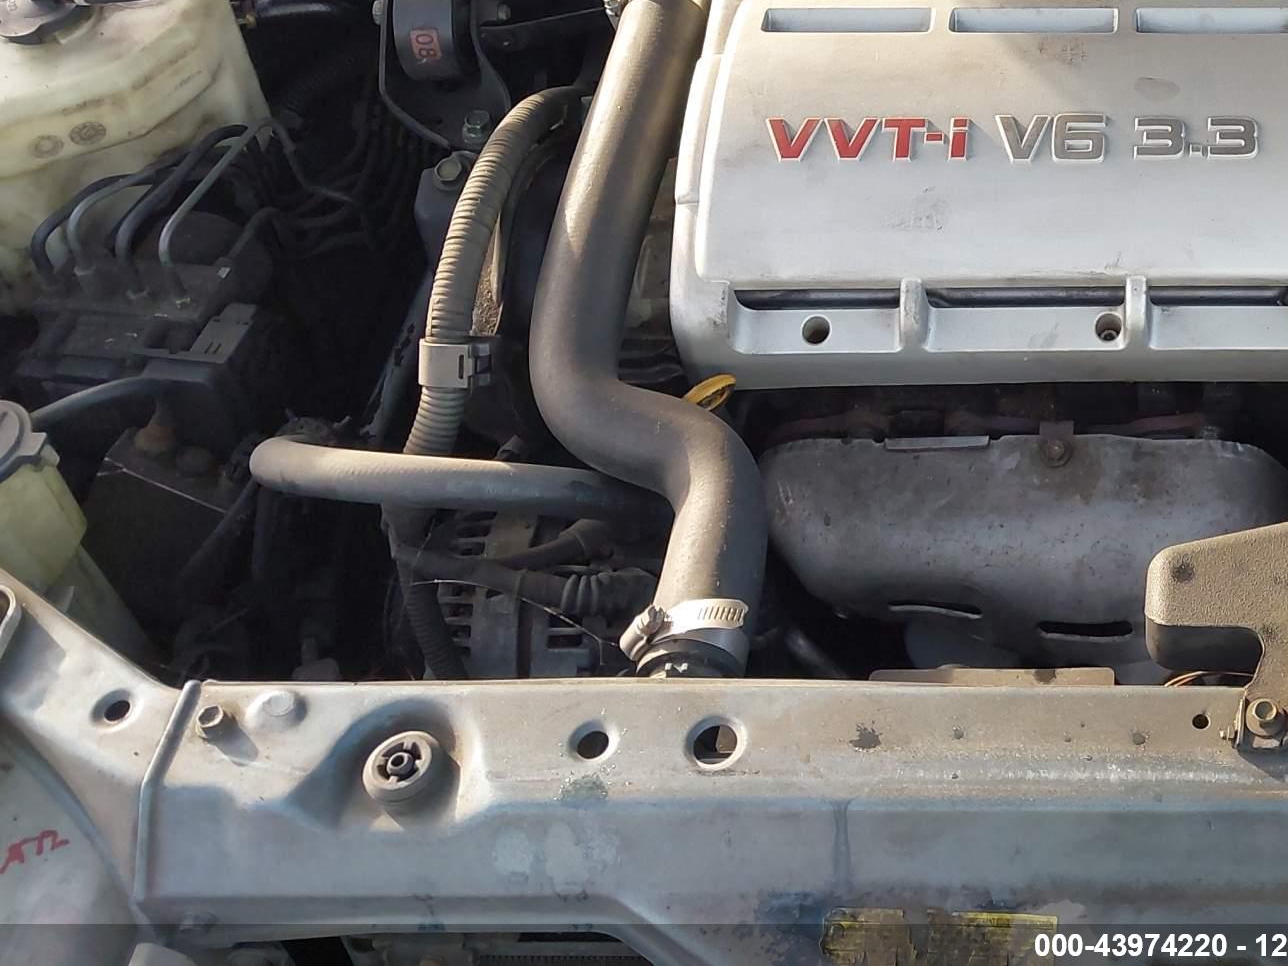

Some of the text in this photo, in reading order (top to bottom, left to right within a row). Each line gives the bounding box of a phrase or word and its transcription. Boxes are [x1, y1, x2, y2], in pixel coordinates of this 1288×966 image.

[765, 113, 1259, 161] VVT-i V6 3.3
